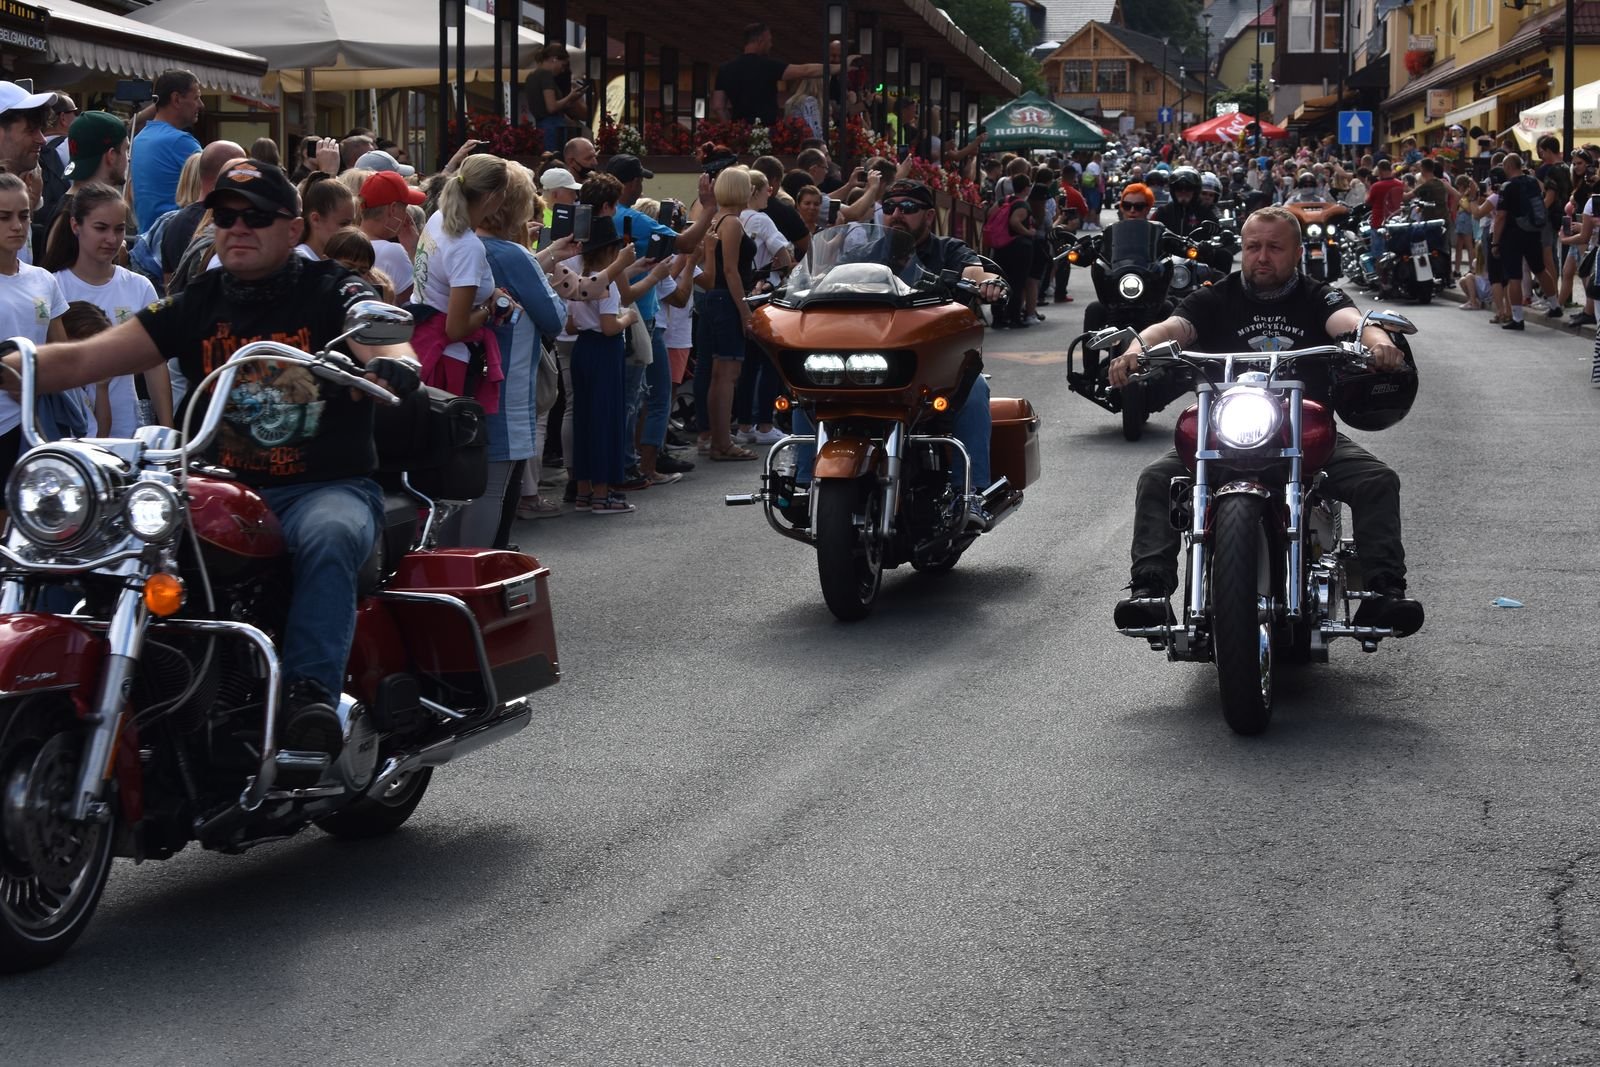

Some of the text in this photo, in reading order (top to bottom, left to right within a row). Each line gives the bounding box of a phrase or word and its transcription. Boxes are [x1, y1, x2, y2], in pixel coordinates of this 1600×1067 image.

[0, 28, 27, 46] BELGIAN
[1253, 314, 1287, 323] GRUPA
[1237, 322, 1305, 337] MOTOCYKLOWA
